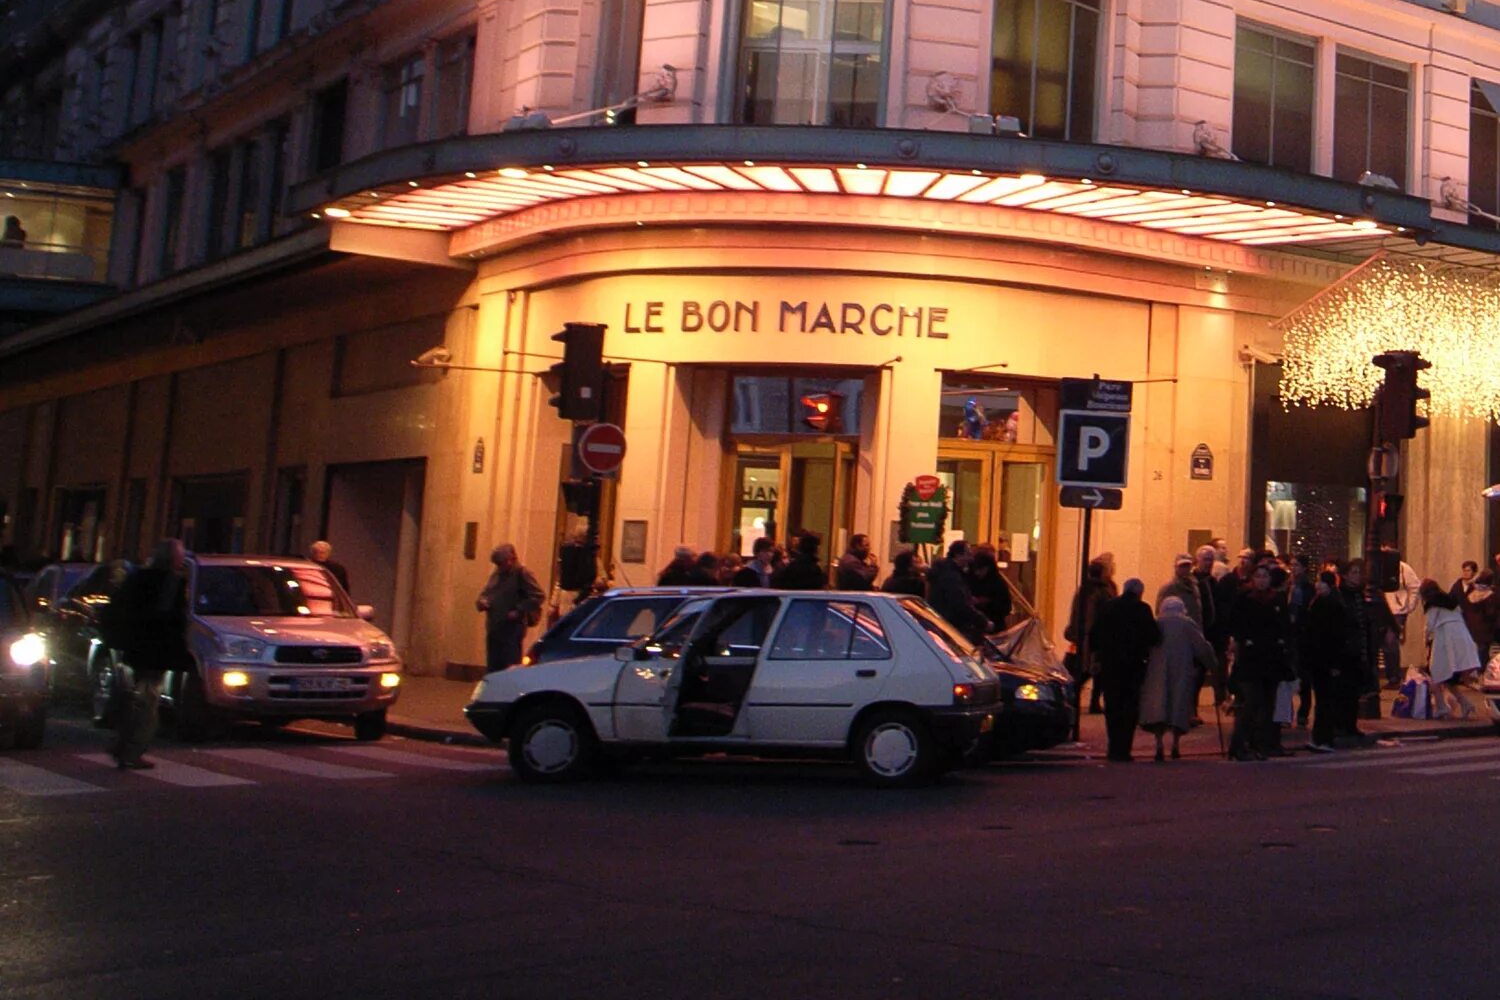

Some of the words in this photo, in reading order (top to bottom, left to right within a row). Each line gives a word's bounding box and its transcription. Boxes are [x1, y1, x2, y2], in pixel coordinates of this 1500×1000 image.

[624, 301, 664, 334] LE
[681, 300, 760, 333] BON
[779, 300, 950, 340] MARCHE
[1077, 425, 1111, 472] P
